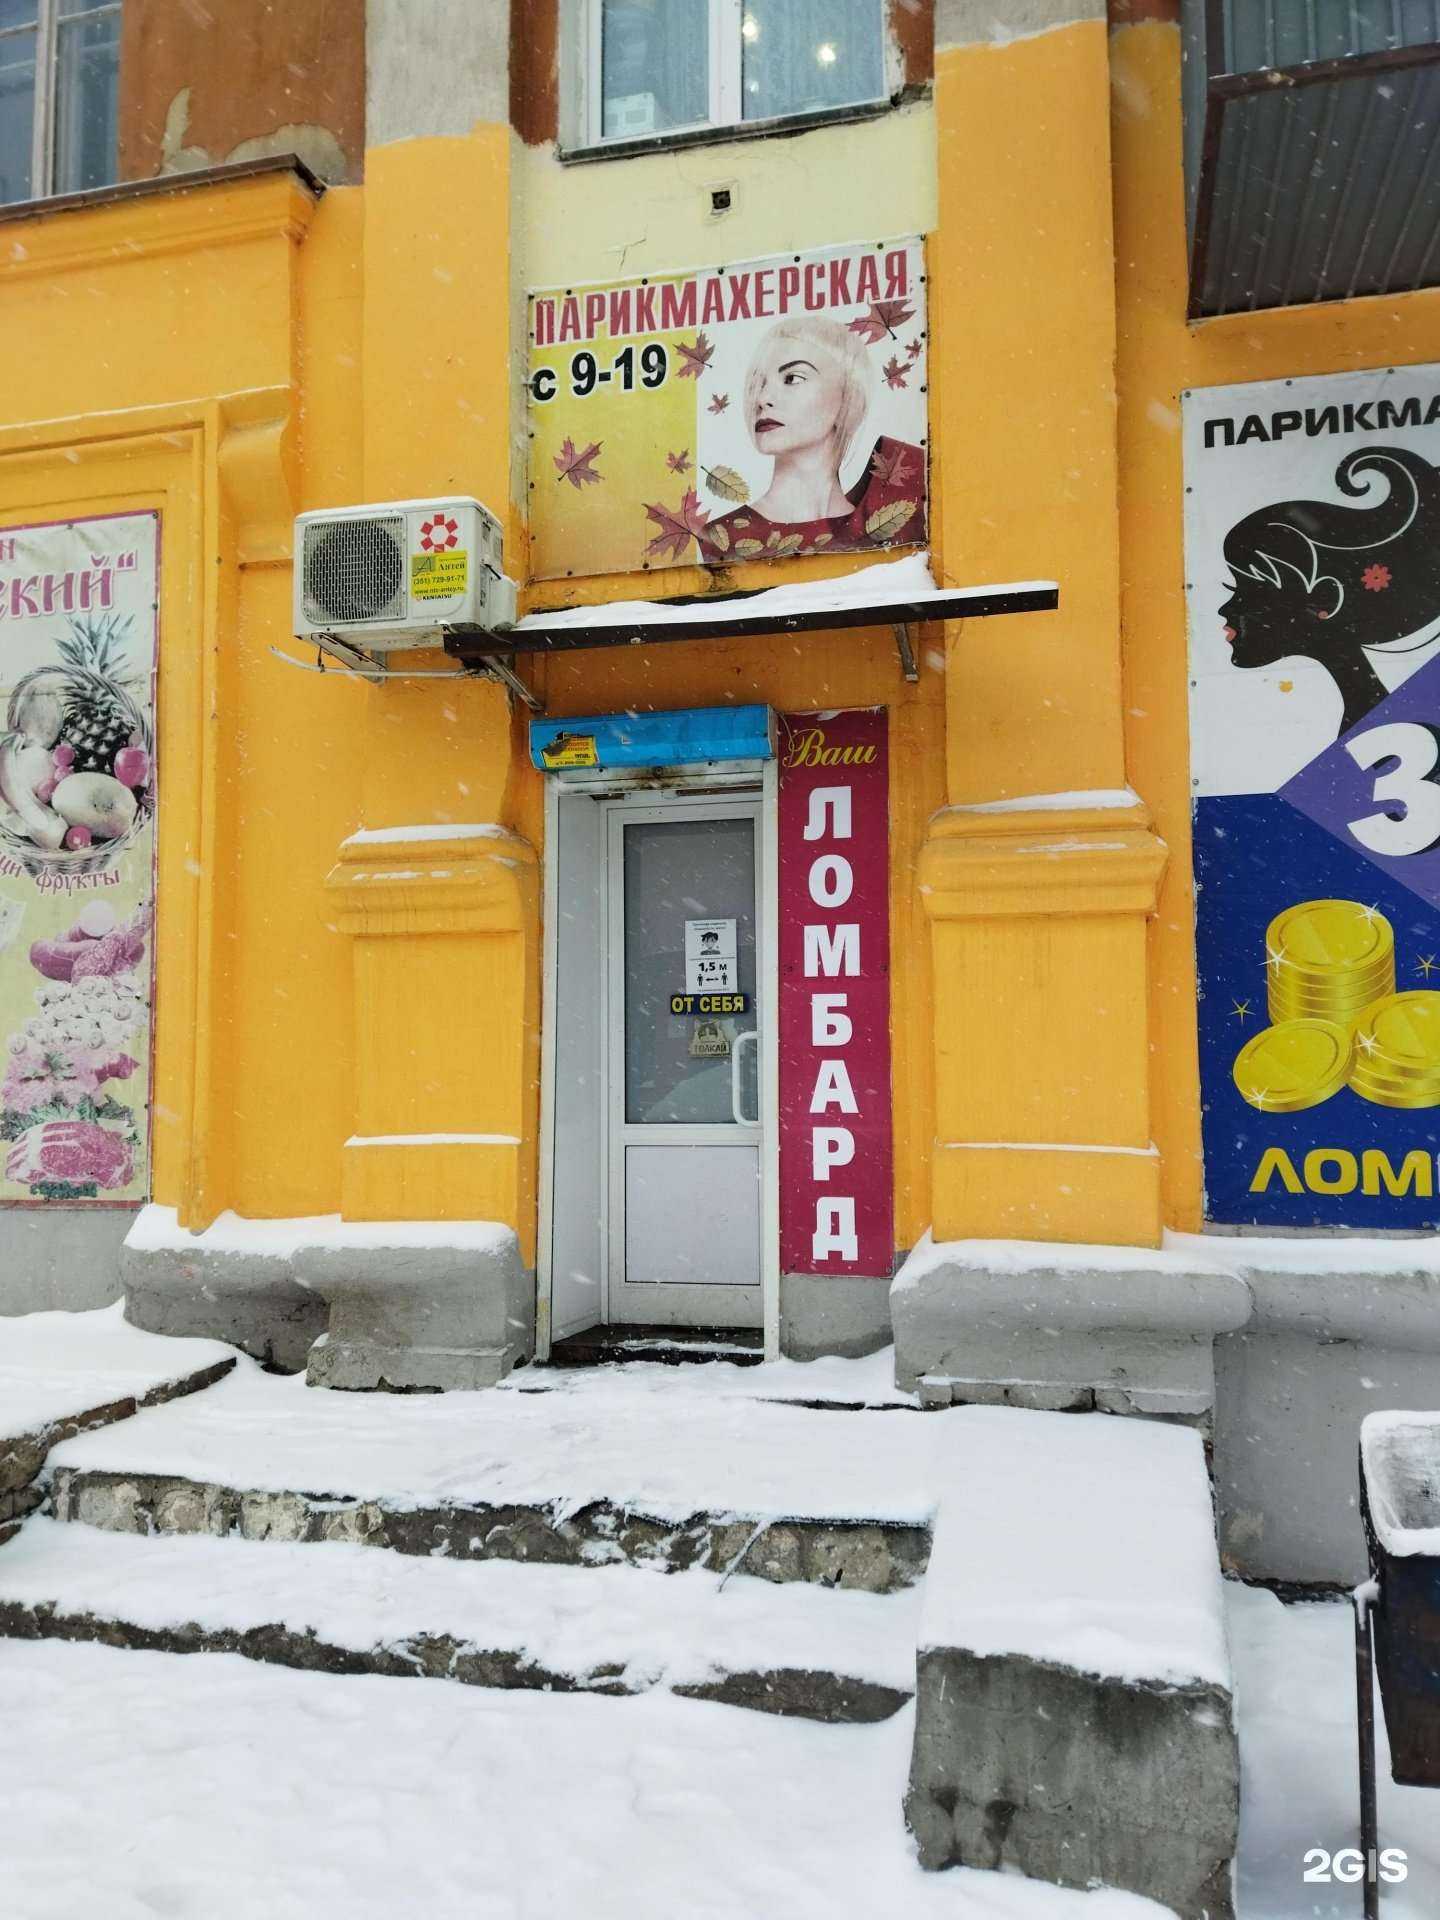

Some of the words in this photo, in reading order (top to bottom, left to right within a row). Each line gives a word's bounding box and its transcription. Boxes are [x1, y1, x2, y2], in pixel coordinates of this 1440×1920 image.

[535, 249, 908, 346] ПАРИКМАХЕРСКАЯ
[571, 344, 667, 397] 9-19
[0, 550, 135, 617] кий“
[783, 730, 877, 768] Ваш
[671, 997, 694, 1012] ОТ
[699, 996, 744, 1012] СЕБЯ
[803, 785, 861, 1262] ЛОМБАРД
[1249, 1148, 1440, 1197] ЛОМ
